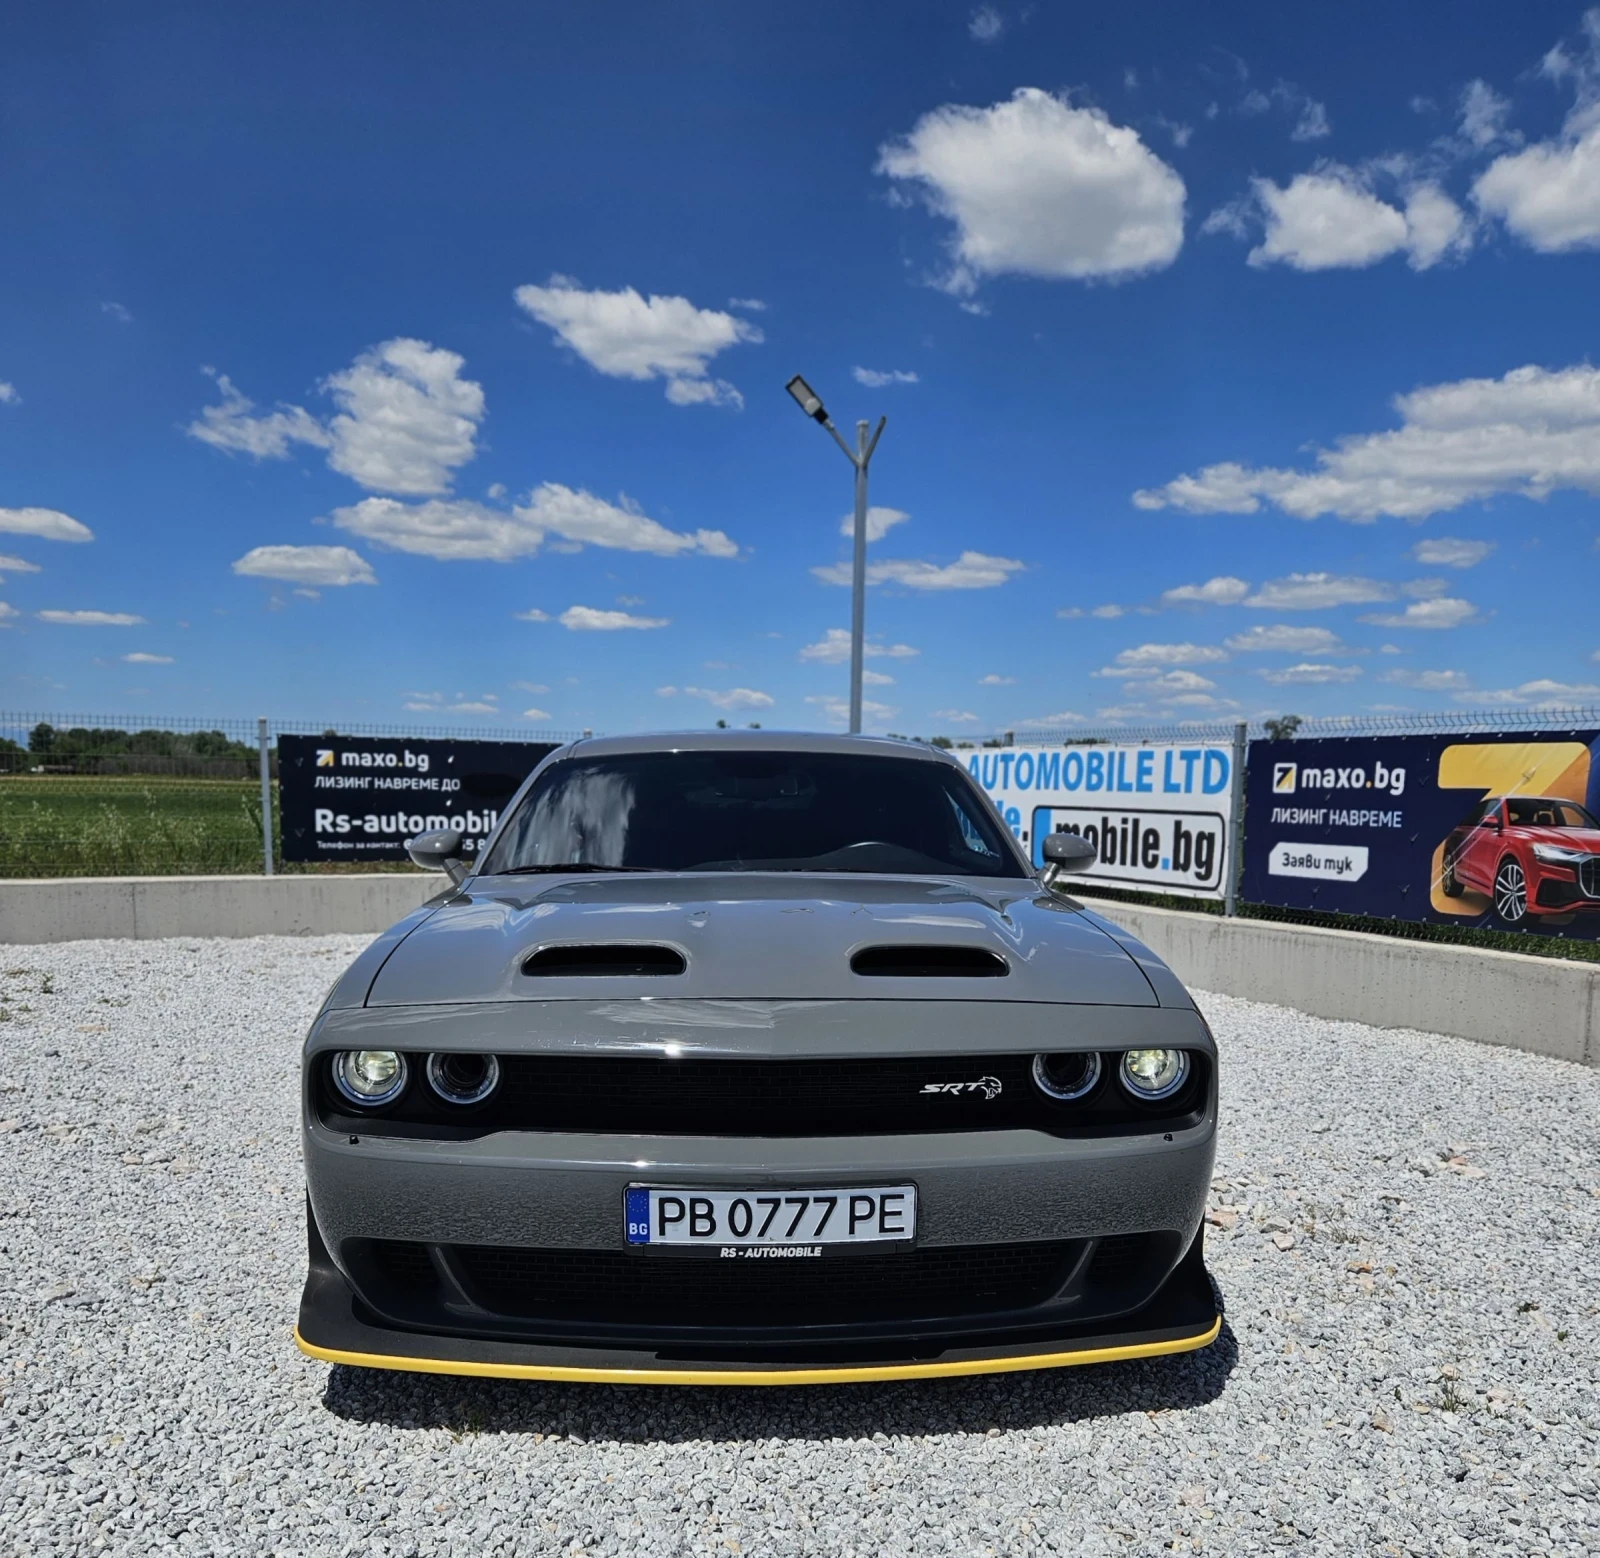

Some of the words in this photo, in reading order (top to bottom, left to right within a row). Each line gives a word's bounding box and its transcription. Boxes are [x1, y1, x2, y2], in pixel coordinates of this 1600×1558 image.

[341, 749, 429, 772] maxo.bg
[968, 750, 1155, 793] AUTOMOBILE
[1163, 749, 1230, 795] LTD
[1301, 761, 1406, 796] maxo.bg
[314, 776, 372, 789] ЛИЗИНГ
[374, 777, 439, 790] НАВРЕМЕ
[440, 778, 461, 791] ДО
[1271, 807, 1328, 825] ЛИЗИНГ
[1329, 809, 1403, 828] НАВРЕМЕ
[316, 840, 354, 850] Телефон
[1282, 852, 1321, 869] Заяви
[1324, 856, 1353, 875] тук
[919, 1082, 985, 1095] SRT
[658, 1197, 717, 1237] PB
[728, 1197, 838, 1237] 0777
[848, 1194, 905, 1235] PE
[629, 1222, 648, 1236] BG
[720, 1247, 737, 1258] RS
[744, 1246, 822, 1258] AUTOMOBILE
